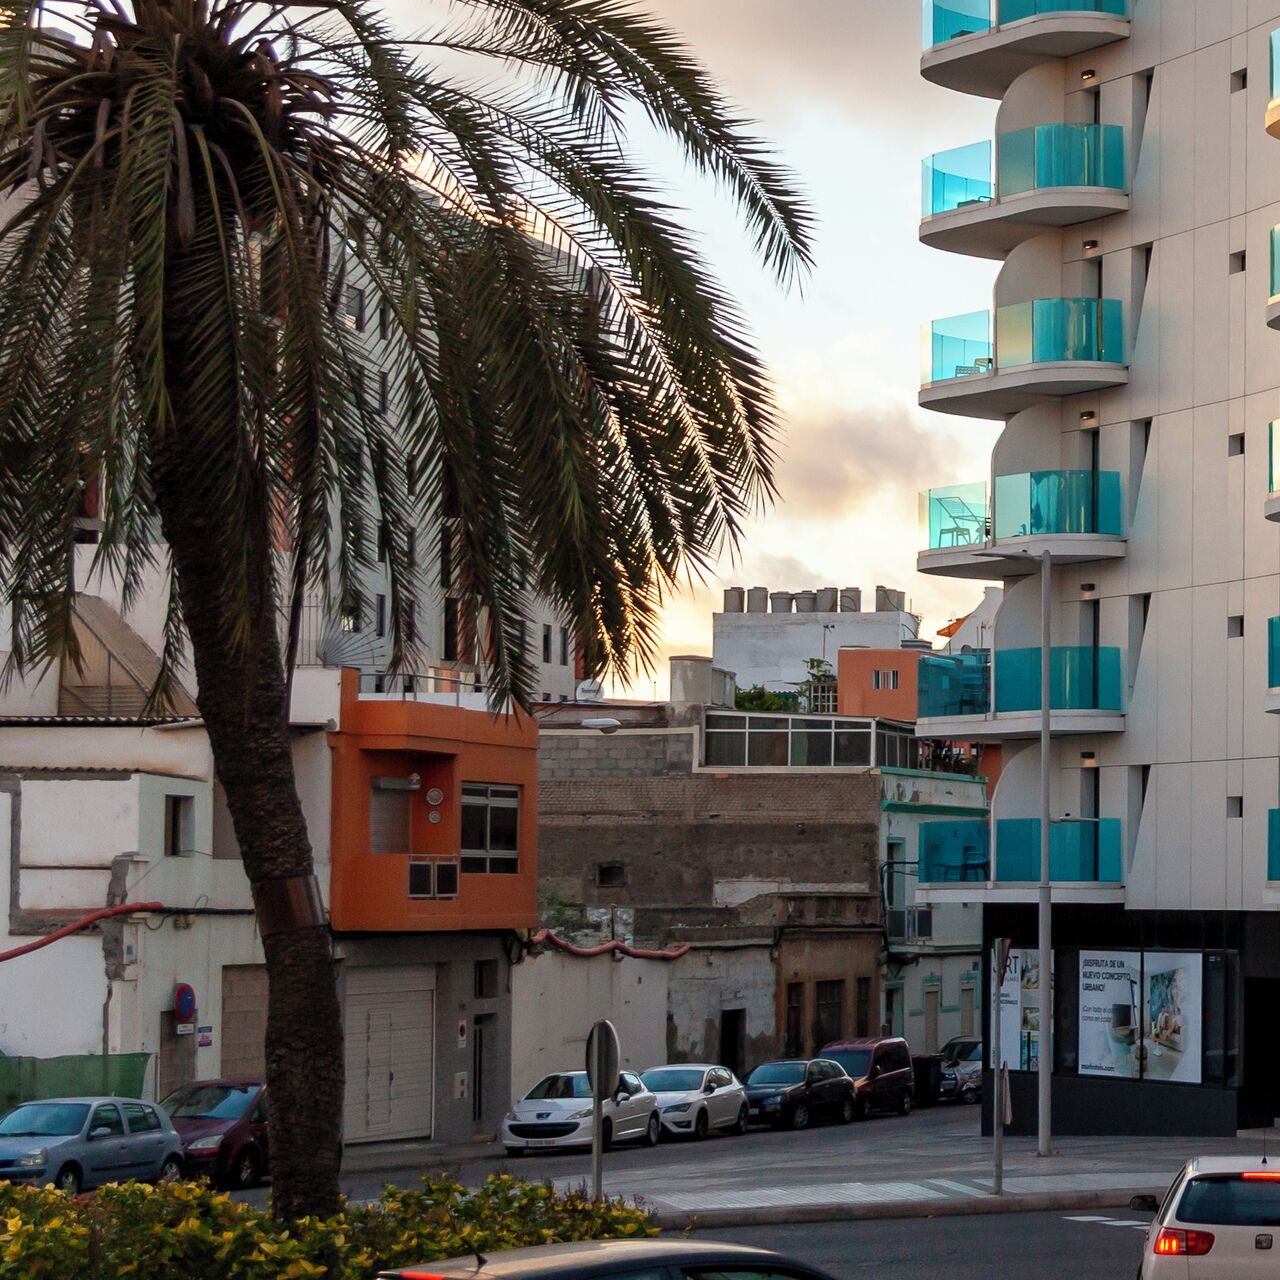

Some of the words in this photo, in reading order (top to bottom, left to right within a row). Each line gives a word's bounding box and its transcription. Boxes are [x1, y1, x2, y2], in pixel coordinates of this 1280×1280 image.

[1082, 959, 1109, 968] ¡DISFRUTA
[1110, 960, 1115, 968] DE
[1082, 971, 1100, 980] NUEVO
[1101, 972, 1131, 981] CONCEPTO
